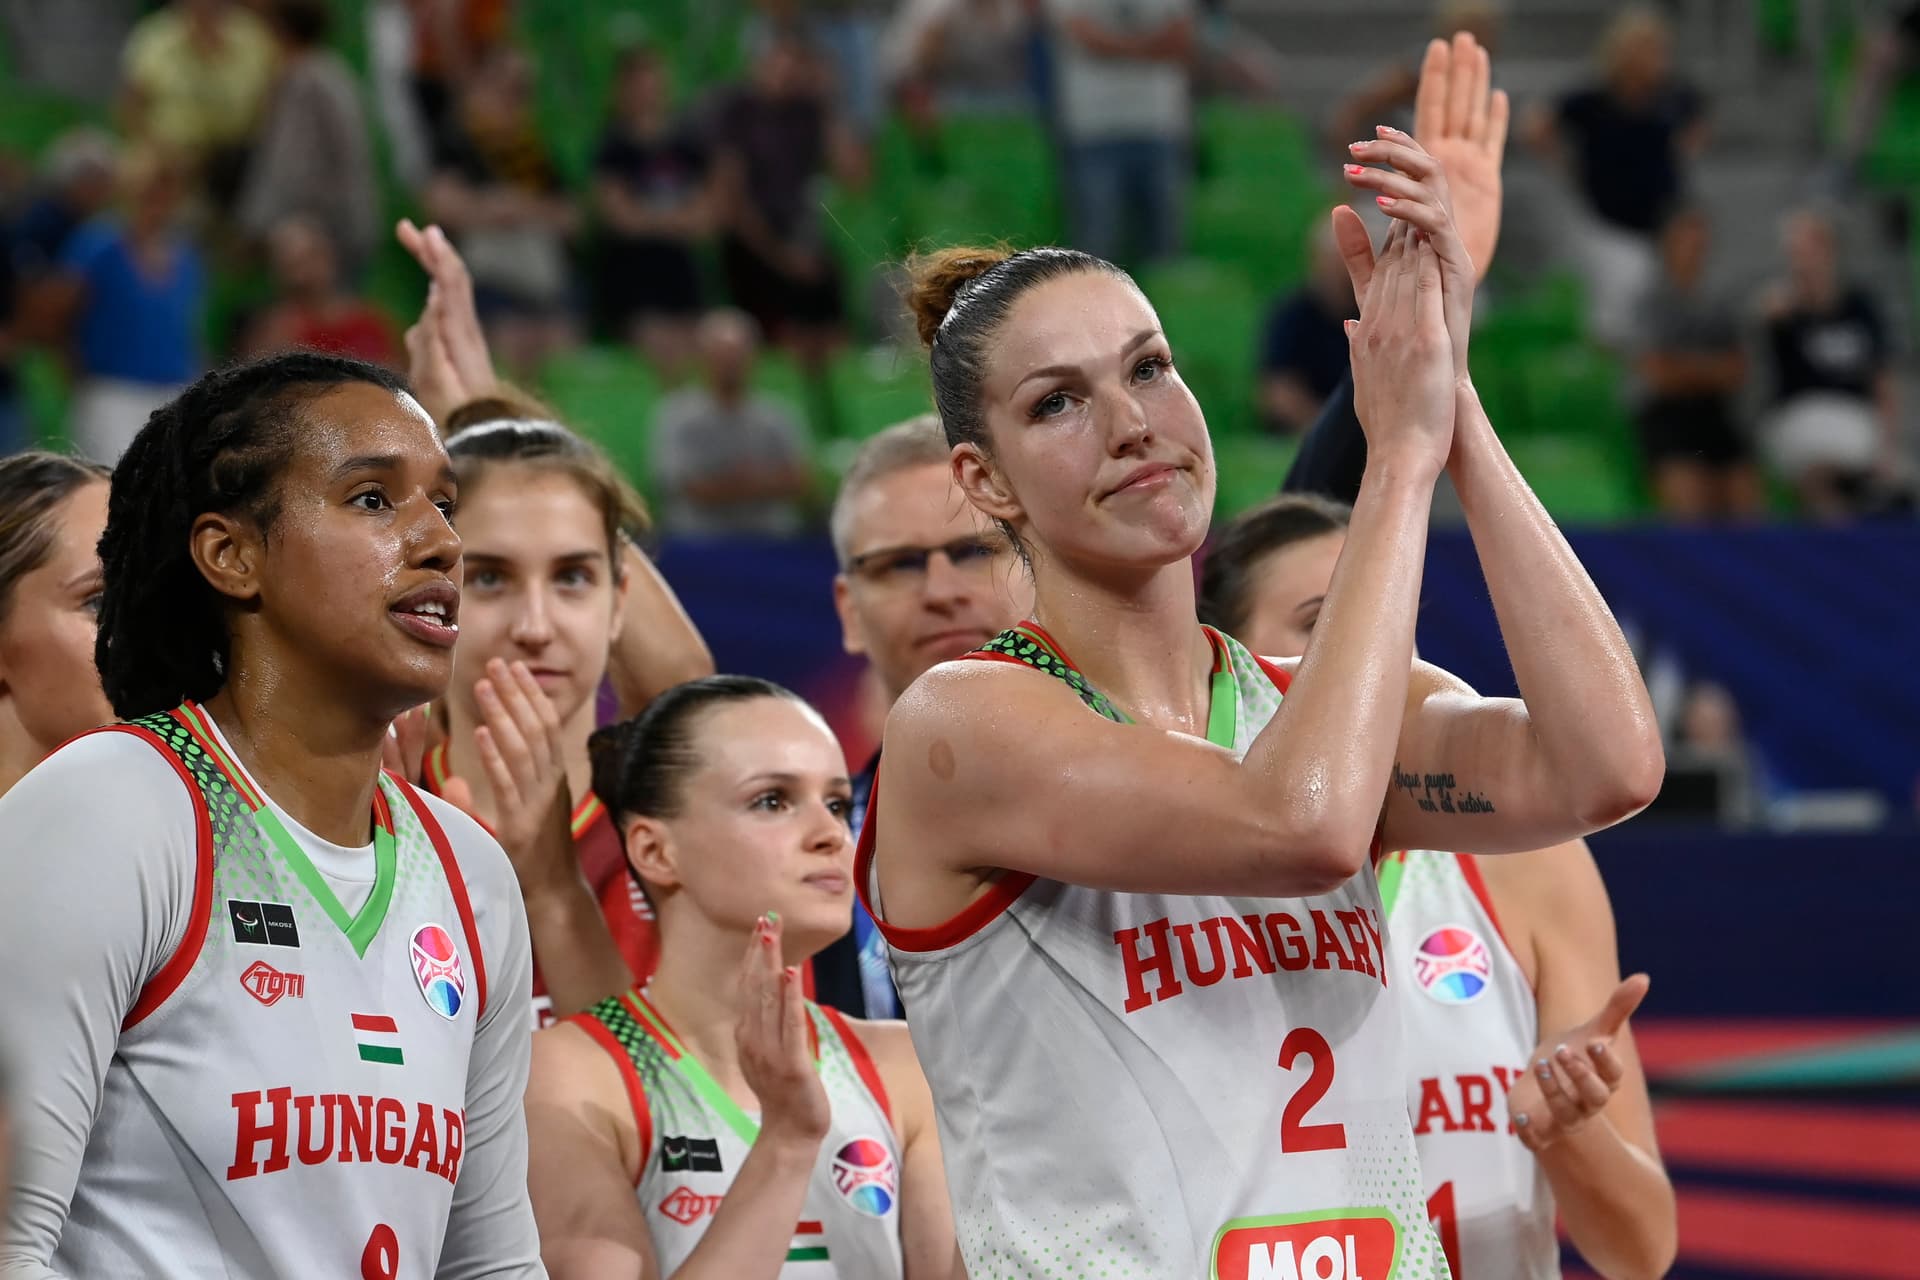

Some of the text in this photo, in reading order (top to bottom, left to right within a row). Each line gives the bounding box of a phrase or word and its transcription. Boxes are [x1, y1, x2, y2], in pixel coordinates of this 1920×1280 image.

[250, 968, 305, 1002] TOTI
[1114, 907, 1388, 1014] HUNGARY
[1278, 1027, 1348, 1154] 2
[227, 1086, 467, 1185] HUNGAR
[667, 1191, 725, 1222] TOT
[1247, 1235, 1363, 1280] MOL
